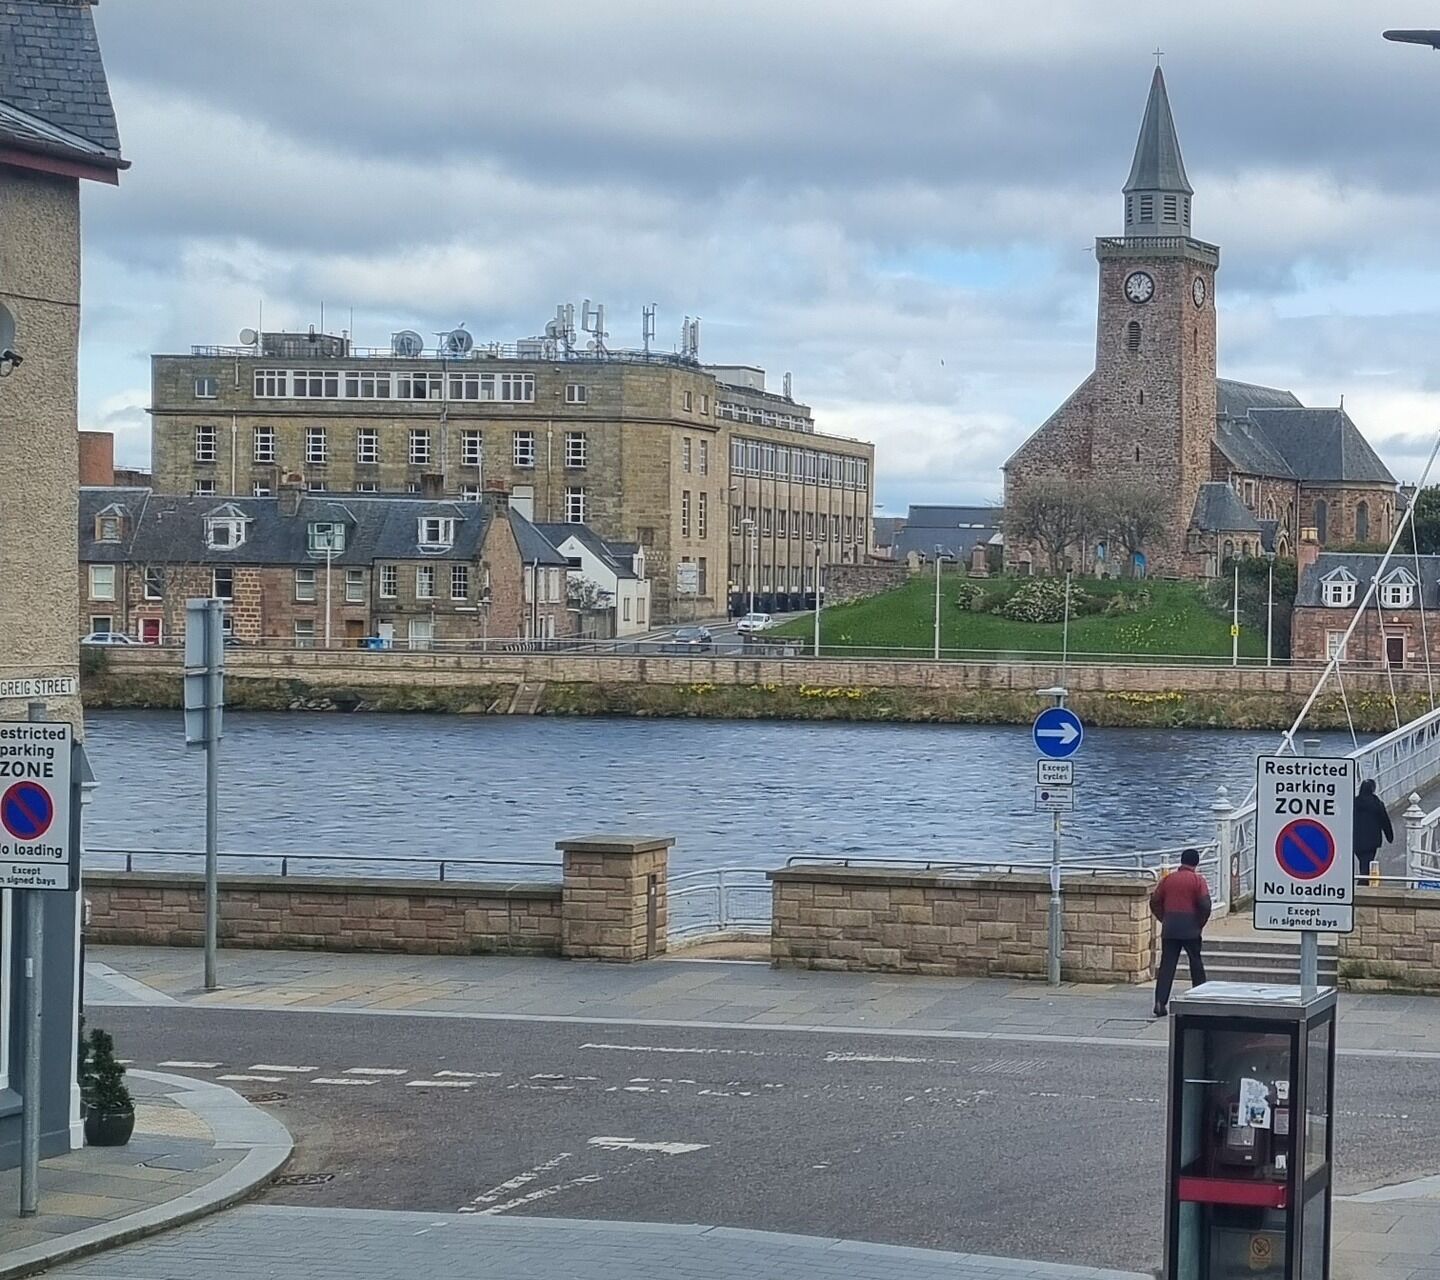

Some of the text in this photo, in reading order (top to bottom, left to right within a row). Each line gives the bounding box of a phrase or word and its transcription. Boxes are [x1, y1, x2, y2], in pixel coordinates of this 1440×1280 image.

[1, 678, 73, 696] GREIG STREET
[0, 726, 66, 740] estricted
[0, 743, 55, 760] parking
[0, 760, 54, 778] ZONE
[1042, 764, 1069, 772] Except
[1265, 761, 1348, 777] Restricted
[1275, 780, 1336, 796] parking
[1275, 798, 1335, 816] ZONE
[0, 842, 63, 859] o loading
[12, 865, 41, 875] Except
[7, 875, 34, 885] signed
[36, 877, 56, 886] bays
[1264, 882, 1345, 899] No loading
[1287, 906, 1321, 917] Except
[1269, 915, 1338, 928] in signed bays
